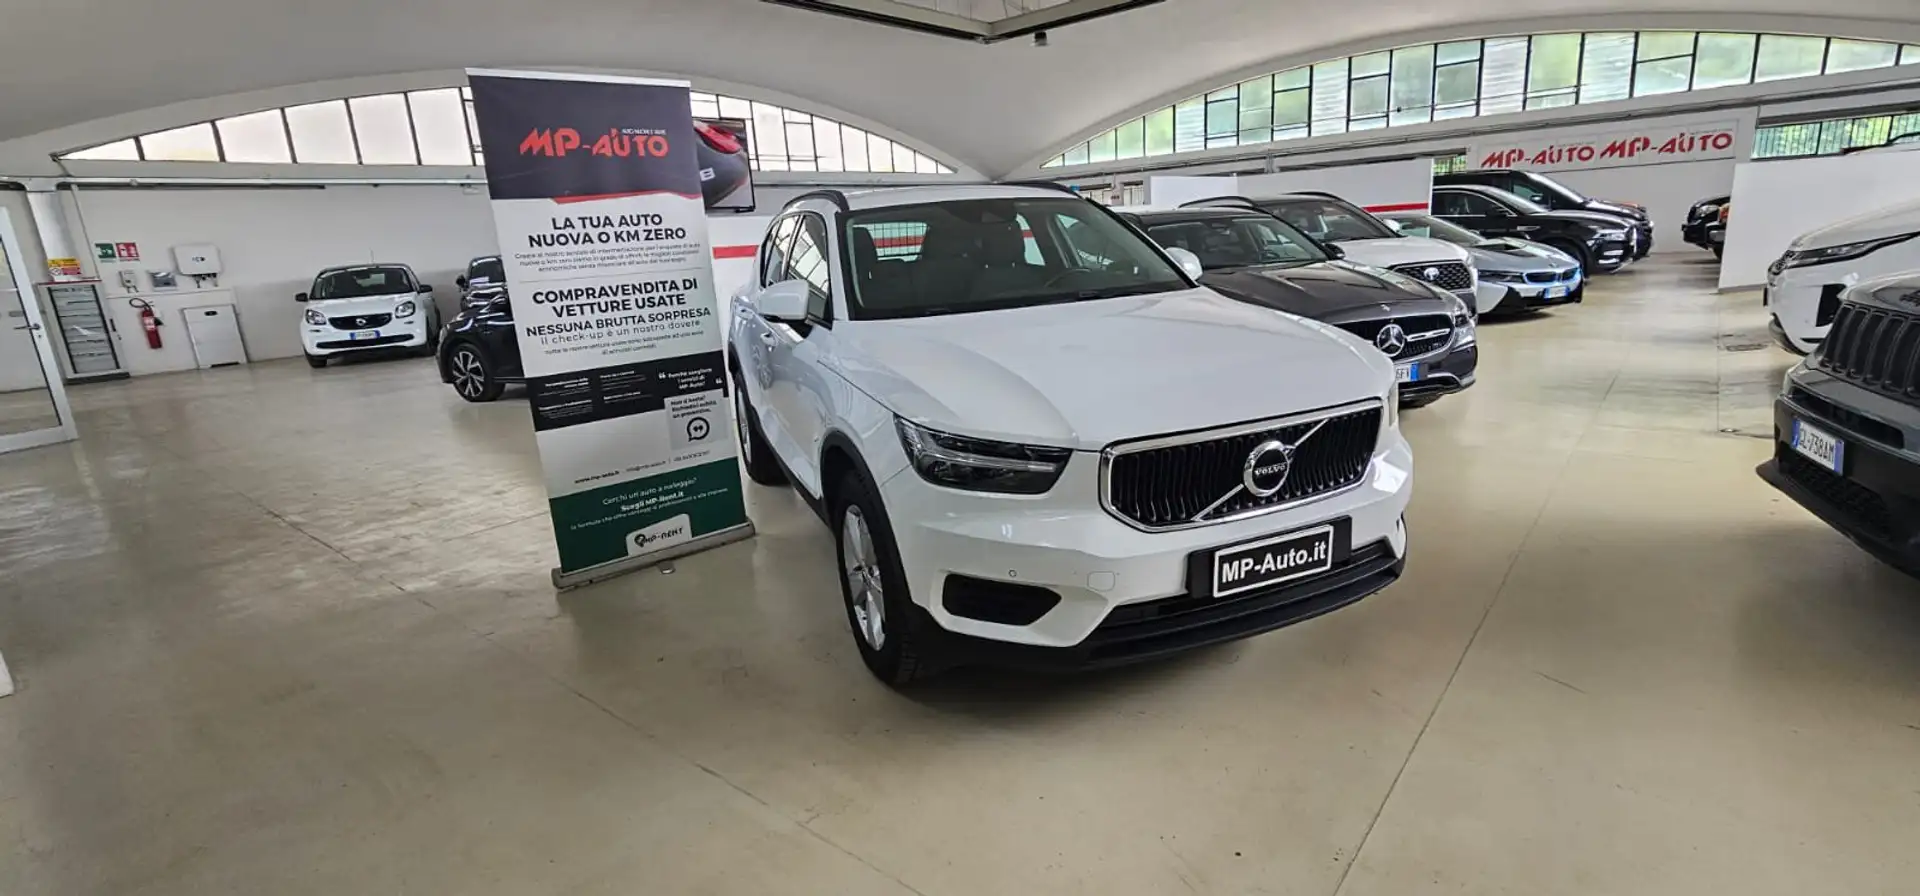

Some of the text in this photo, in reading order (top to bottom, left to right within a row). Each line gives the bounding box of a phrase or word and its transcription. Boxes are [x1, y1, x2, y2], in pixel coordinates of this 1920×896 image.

[552, 213, 663, 230] LA TUA AUTO
[528, 232, 593, 248] NUOVA
[614, 228, 640, 242] KM
[644, 227, 686, 241] ZERO
[532, 278, 698, 304] COMPRAVENDITA DI
[552, 293, 686, 318] VETTURE USATE
[526, 307, 711, 337] NESSUNA BRUTTA SORPRESA
[552, 329, 604, 344] check-up
[616, 327, 630, 336] un
[633, 322, 665, 334] nostro
[1254, 463, 1286, 476] VOLVO
[1222, 540, 1327, 583] MP-Auto.it
